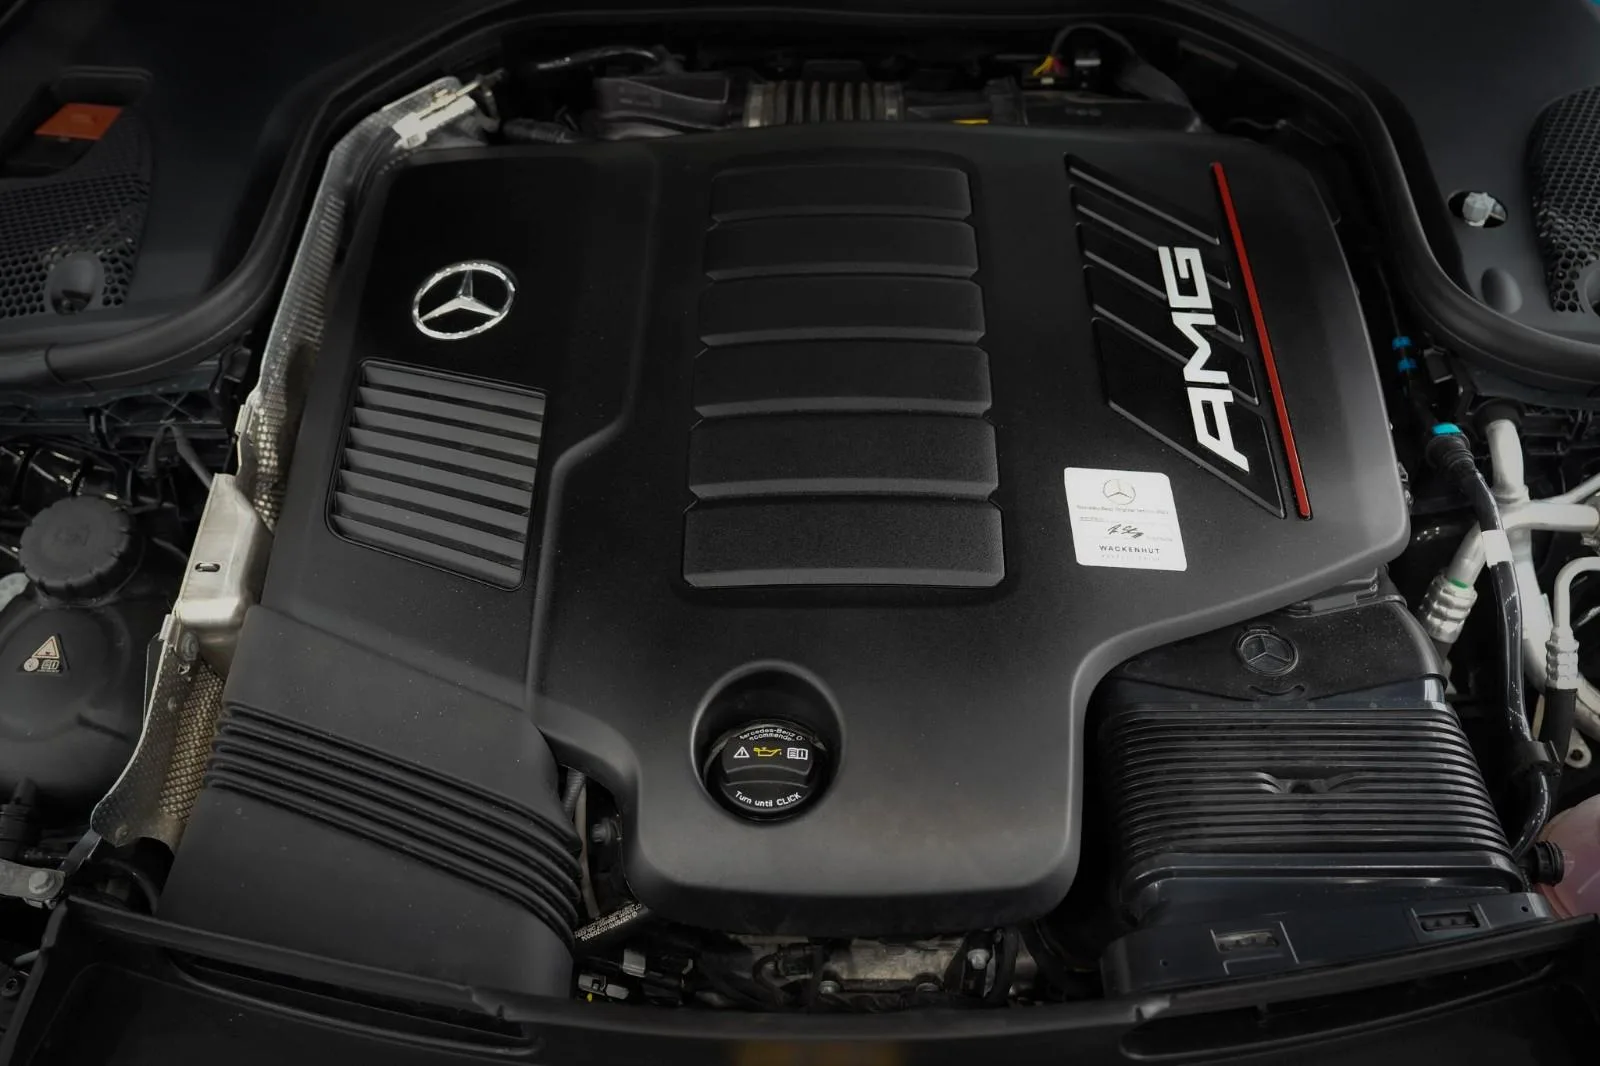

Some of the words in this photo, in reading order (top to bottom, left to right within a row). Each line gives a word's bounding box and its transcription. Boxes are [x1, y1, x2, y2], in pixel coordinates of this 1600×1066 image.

[1158, 246, 1250, 474] AMG
[1099, 544, 1161, 554] WACKENHUT
[735, 790, 752, 805] Turn
[754, 798, 773, 808] until
[776, 791, 802, 806] CLICK
